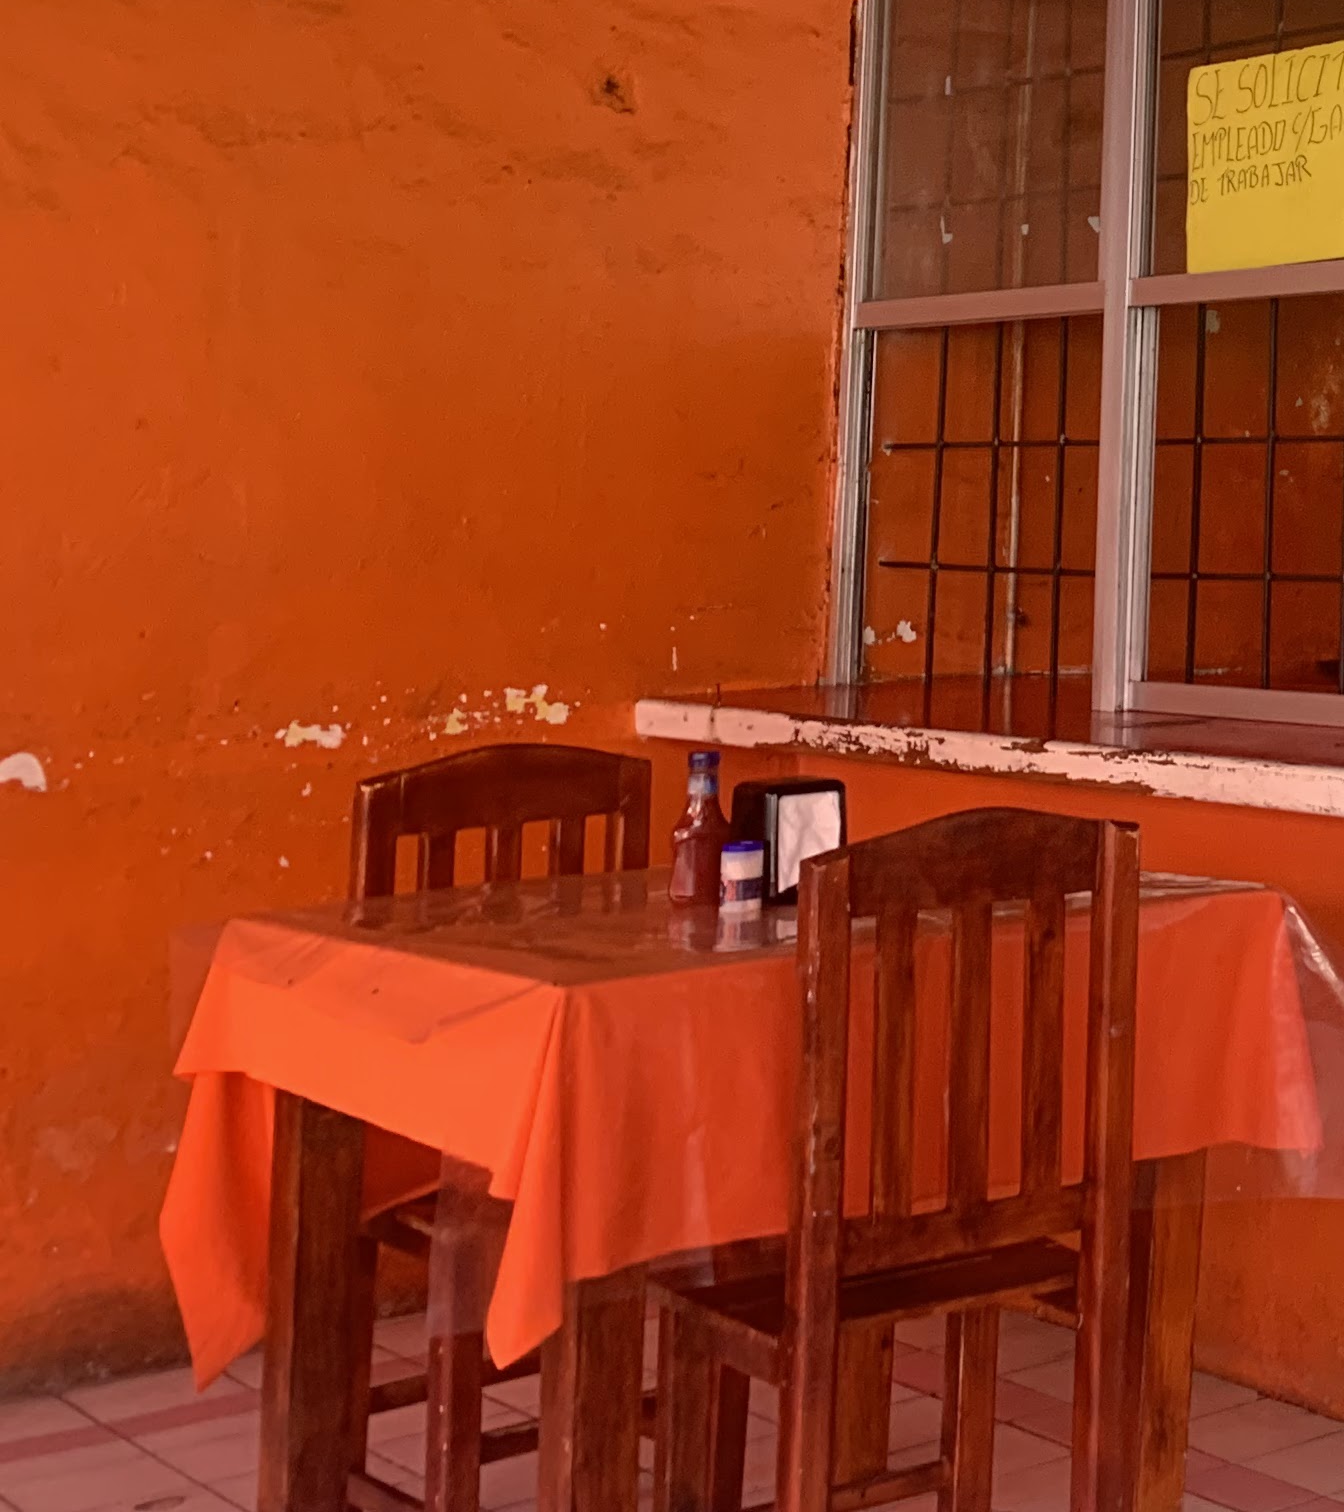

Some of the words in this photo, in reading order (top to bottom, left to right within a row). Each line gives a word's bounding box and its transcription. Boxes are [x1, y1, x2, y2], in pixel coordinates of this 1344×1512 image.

[1194, 69, 1225, 126] SE
[1192, 119, 1286, 172] EMPLEADO
[1190, 177, 1208, 205] DE
[1217, 154, 1312, 196] TRABAJAR
